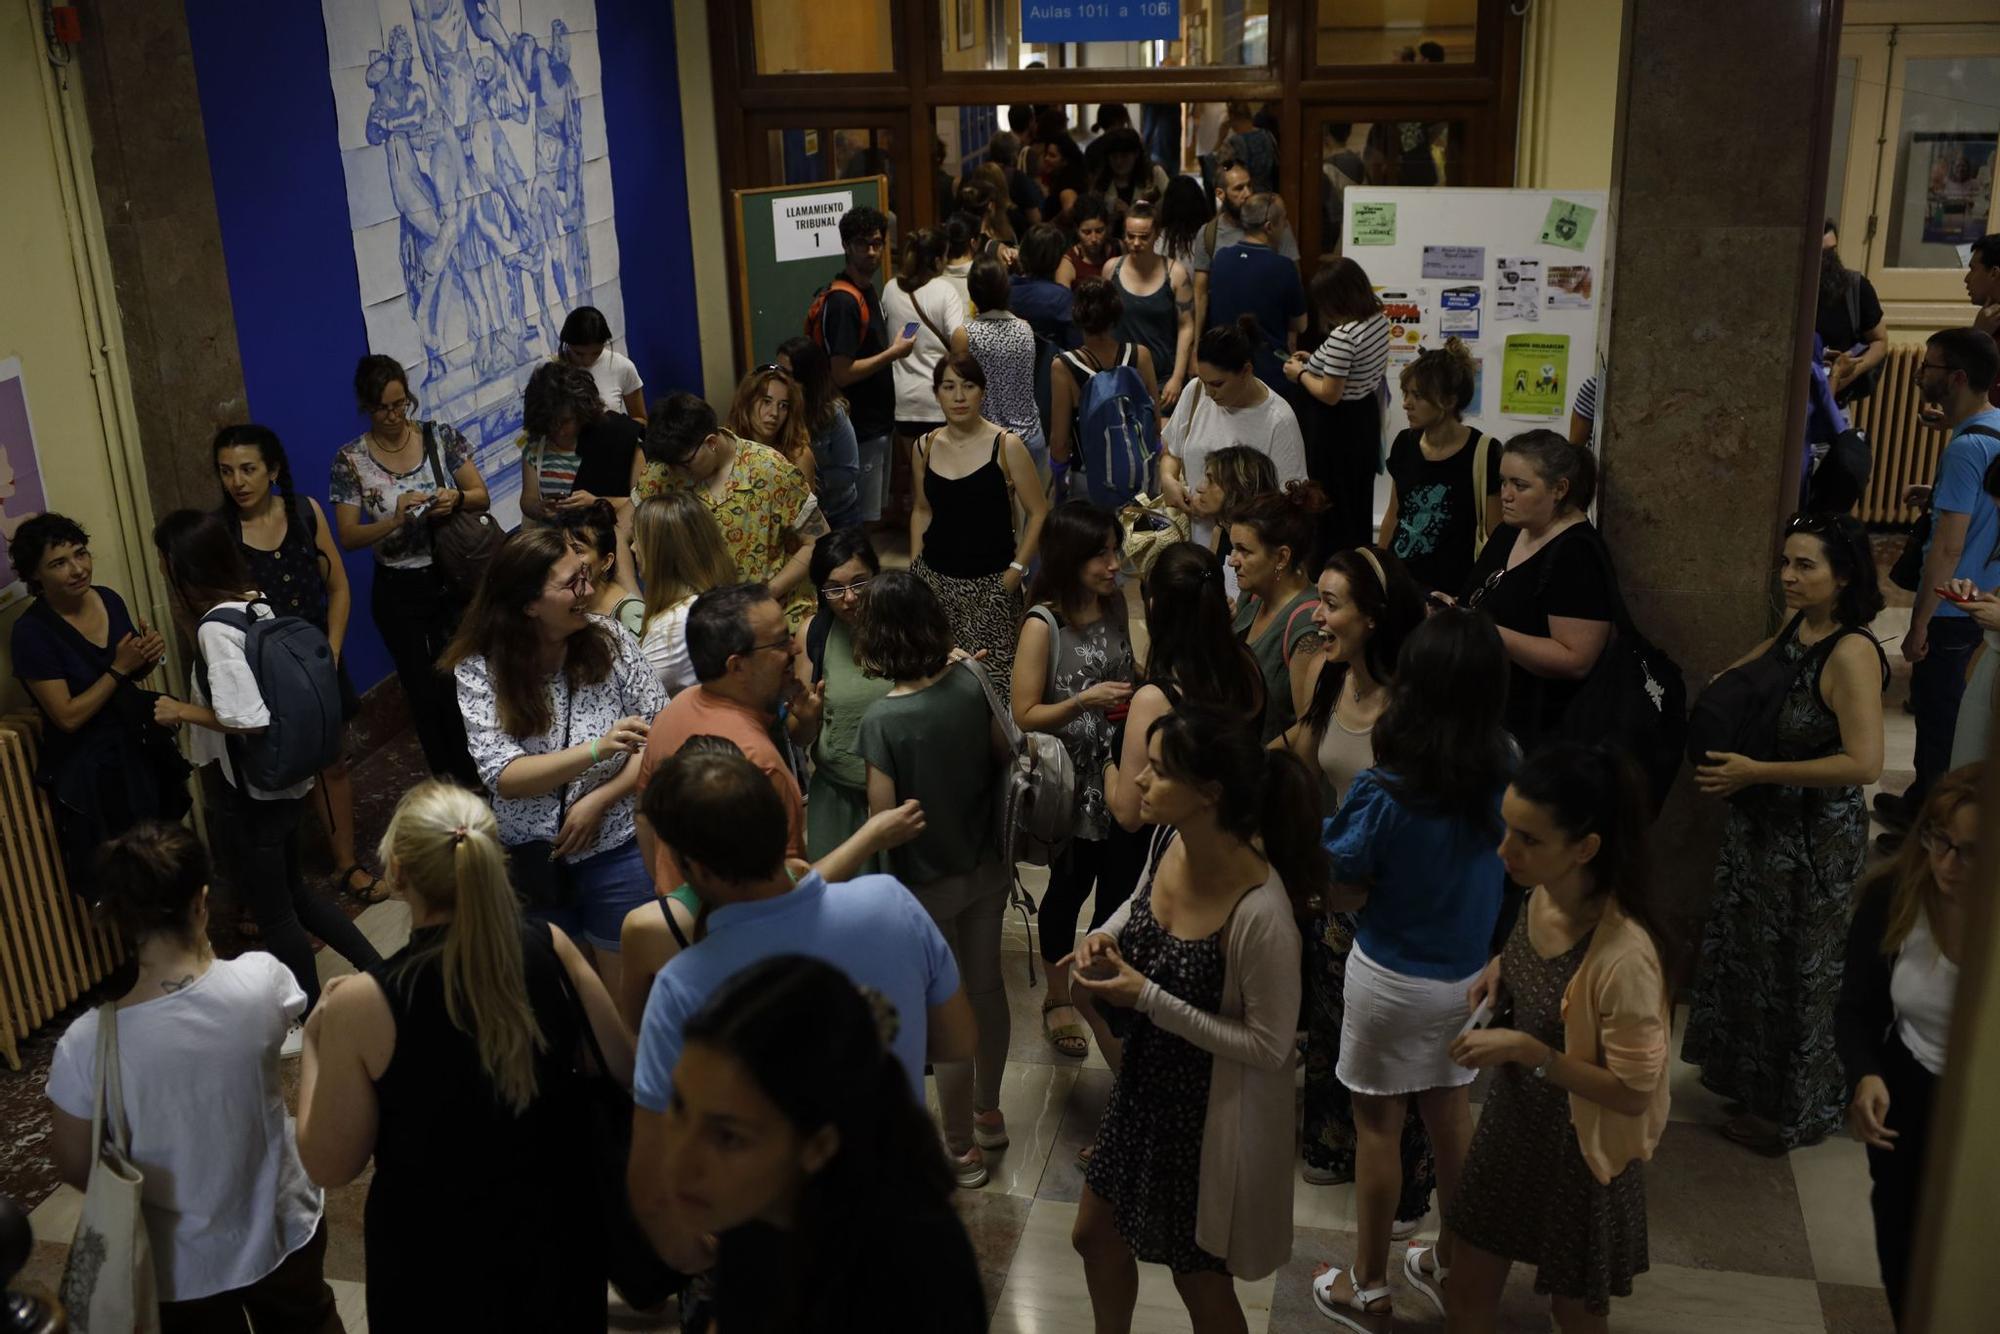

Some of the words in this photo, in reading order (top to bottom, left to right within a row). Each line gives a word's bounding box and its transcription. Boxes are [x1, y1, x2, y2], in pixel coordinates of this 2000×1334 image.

[1030, 5, 1071, 18] Aulas
[1078, 4, 1109, 17] 101i
[1119, 6, 1128, 17] a
[1140, 2, 1170, 16] 106i
[786, 203, 843, 217] LLAMAMIENTO
[796, 217, 836, 229] TRIBUNAL
[814, 233, 819, 247] 1
